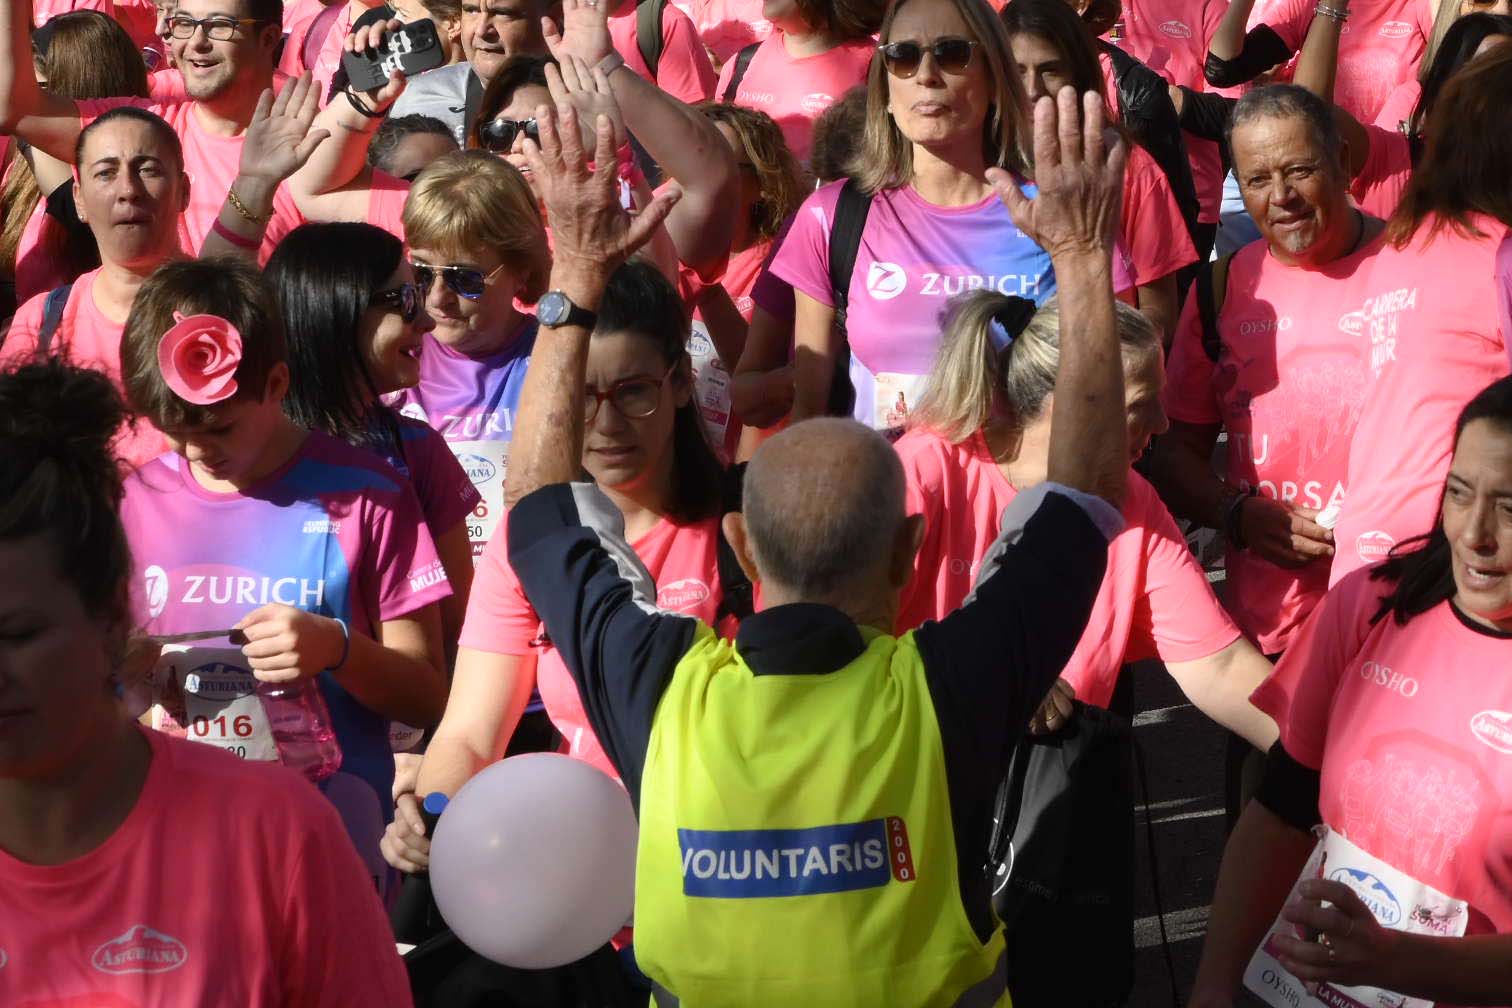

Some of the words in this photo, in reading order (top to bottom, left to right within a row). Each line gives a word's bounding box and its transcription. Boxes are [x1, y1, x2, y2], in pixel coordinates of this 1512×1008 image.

[919, 273, 1041, 296] ZURICH
[1362, 288, 1417, 321] CARRERA
[1240, 317, 1293, 336] OYSHO
[1235, 433, 1268, 465] TU
[180, 574, 325, 606] ZURICH
[681, 837, 886, 882] VOLUNTARIS
[890, 818, 912, 881] 2000
